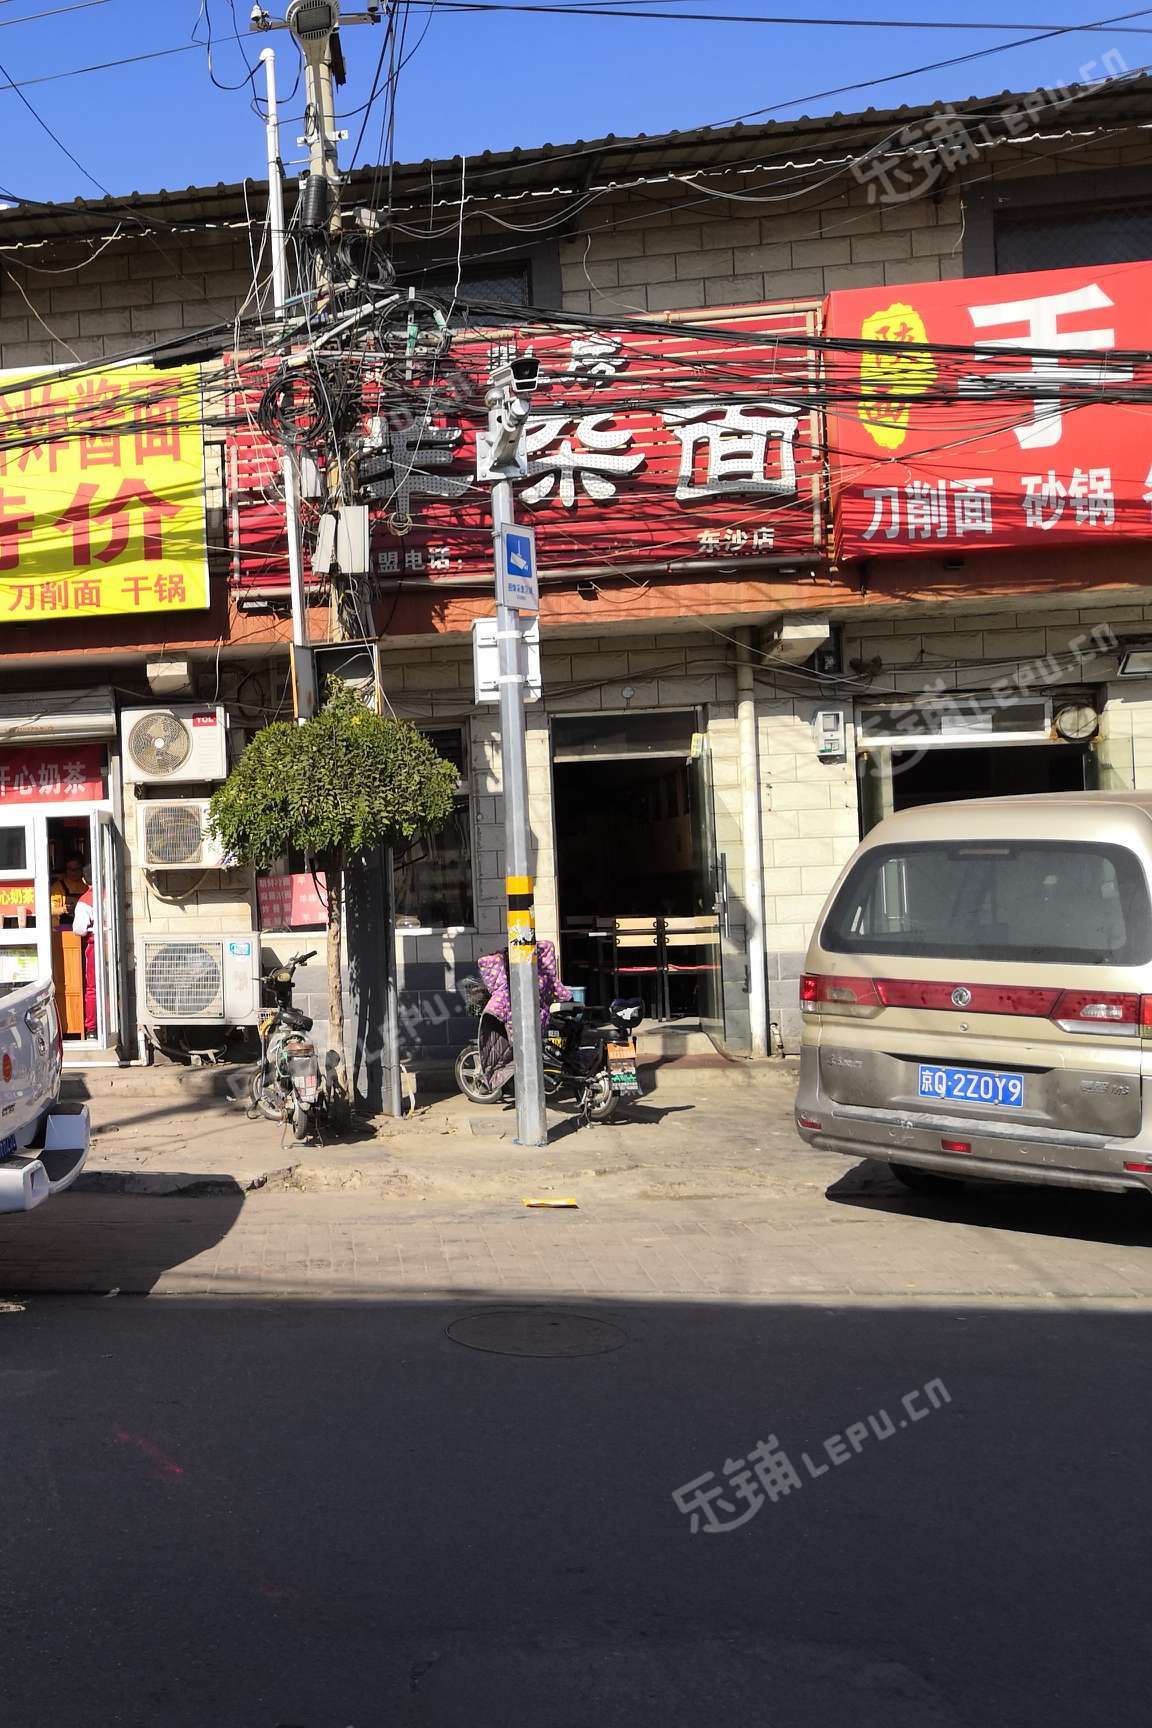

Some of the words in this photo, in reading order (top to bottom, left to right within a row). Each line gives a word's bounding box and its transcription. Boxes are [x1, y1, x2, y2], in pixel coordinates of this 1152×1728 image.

[862, 477, 994, 541] 刀削面
[1021, 467, 1115, 530] 砂锅
[8, 578, 102, 611] 刀削面
[120, 573, 187, 605] 干锅
